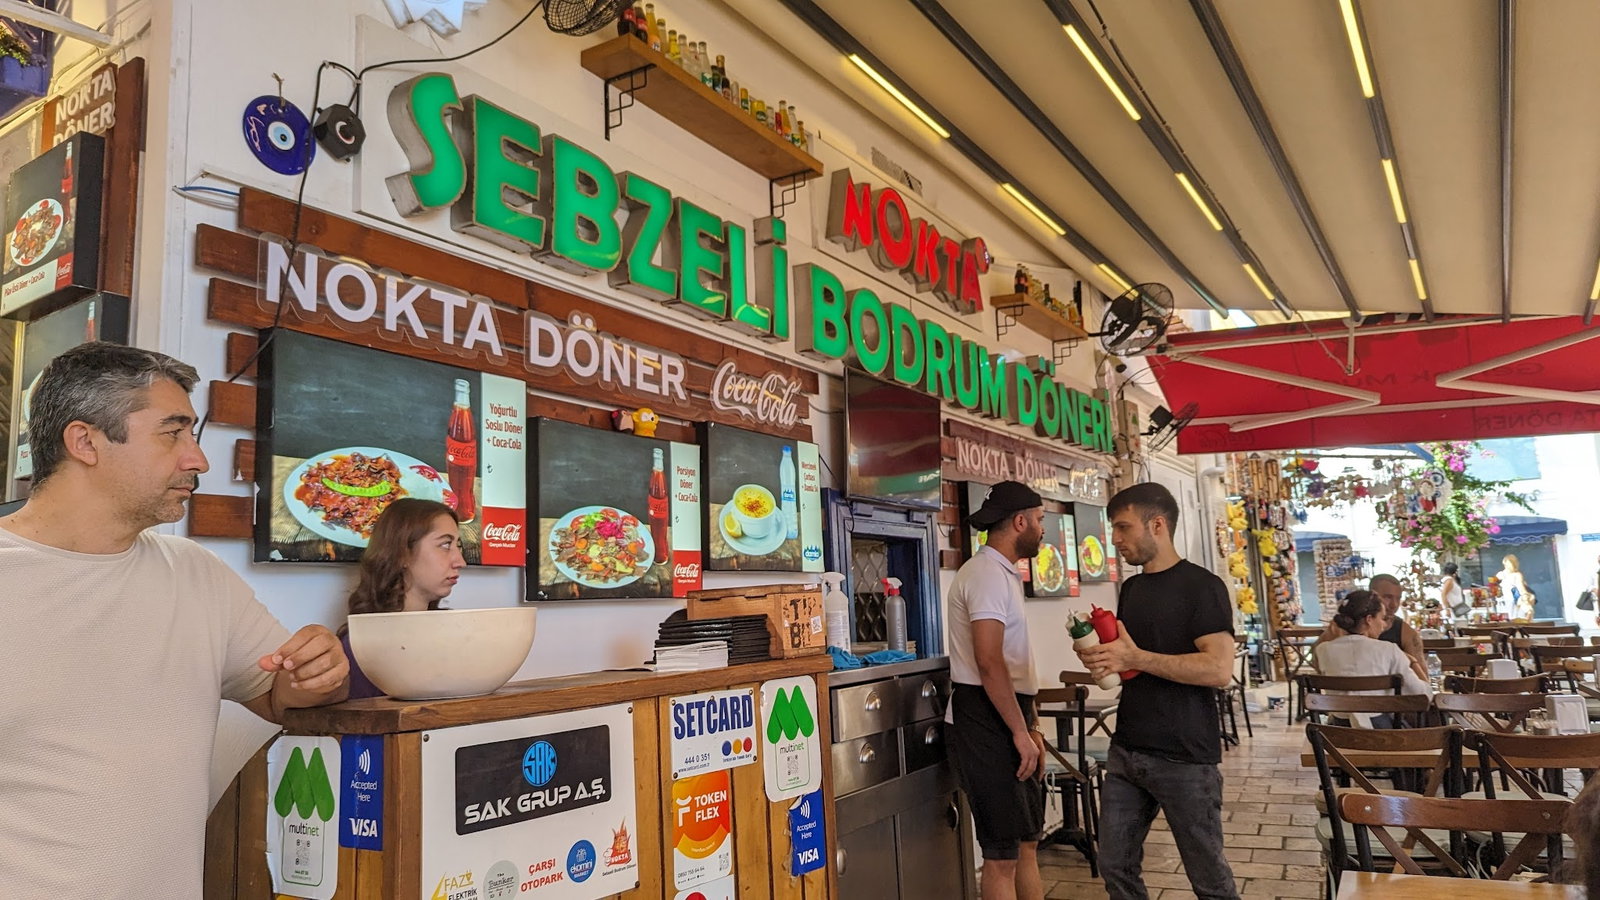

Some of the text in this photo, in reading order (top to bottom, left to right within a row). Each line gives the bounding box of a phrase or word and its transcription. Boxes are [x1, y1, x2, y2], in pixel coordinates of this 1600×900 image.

[55, 69, 113, 125] NOKTA
[388, 73, 790, 342] SEBZELİ
[836, 172, 984, 312] NOKTA
[266, 242, 687, 400] NOKTA DÖNER
[806, 263, 1115, 454] BODRUM DÖNERİ
[711, 361, 801, 427] Coca-Cola
[489, 402, 518, 419] Yoğurtlu
[485, 418, 524, 435] Soslu Döner
[492, 436, 522, 450] Coca-Cola
[957, 438, 1011, 478] NOKTA
[484, 522, 523, 541] Coca-Cola
[673, 694, 754, 740] SETCARD
[779, 741, 805, 755] multinet
[523, 741, 557, 787] SAK
[684, 755, 695, 764] 444
[351, 780, 377, 790] Accepted
[357, 792, 371, 802] Here
[464, 797, 512, 825] SAK
[517, 785, 572, 813] GRUP
[694, 790, 727, 808] TOKEN
[695, 806, 720, 823] FLEX
[289, 822, 319, 837] multinet
[349, 818, 378, 838] VISA
[796, 820, 817, 832] Accepted
[801, 832, 812, 840] Here
[797, 847, 819, 866] VISA
[528, 858, 556, 876] ÇARŞI
[520, 871, 564, 893] OTOPARK
[448, 887, 478, 900] ELEKTRİK
